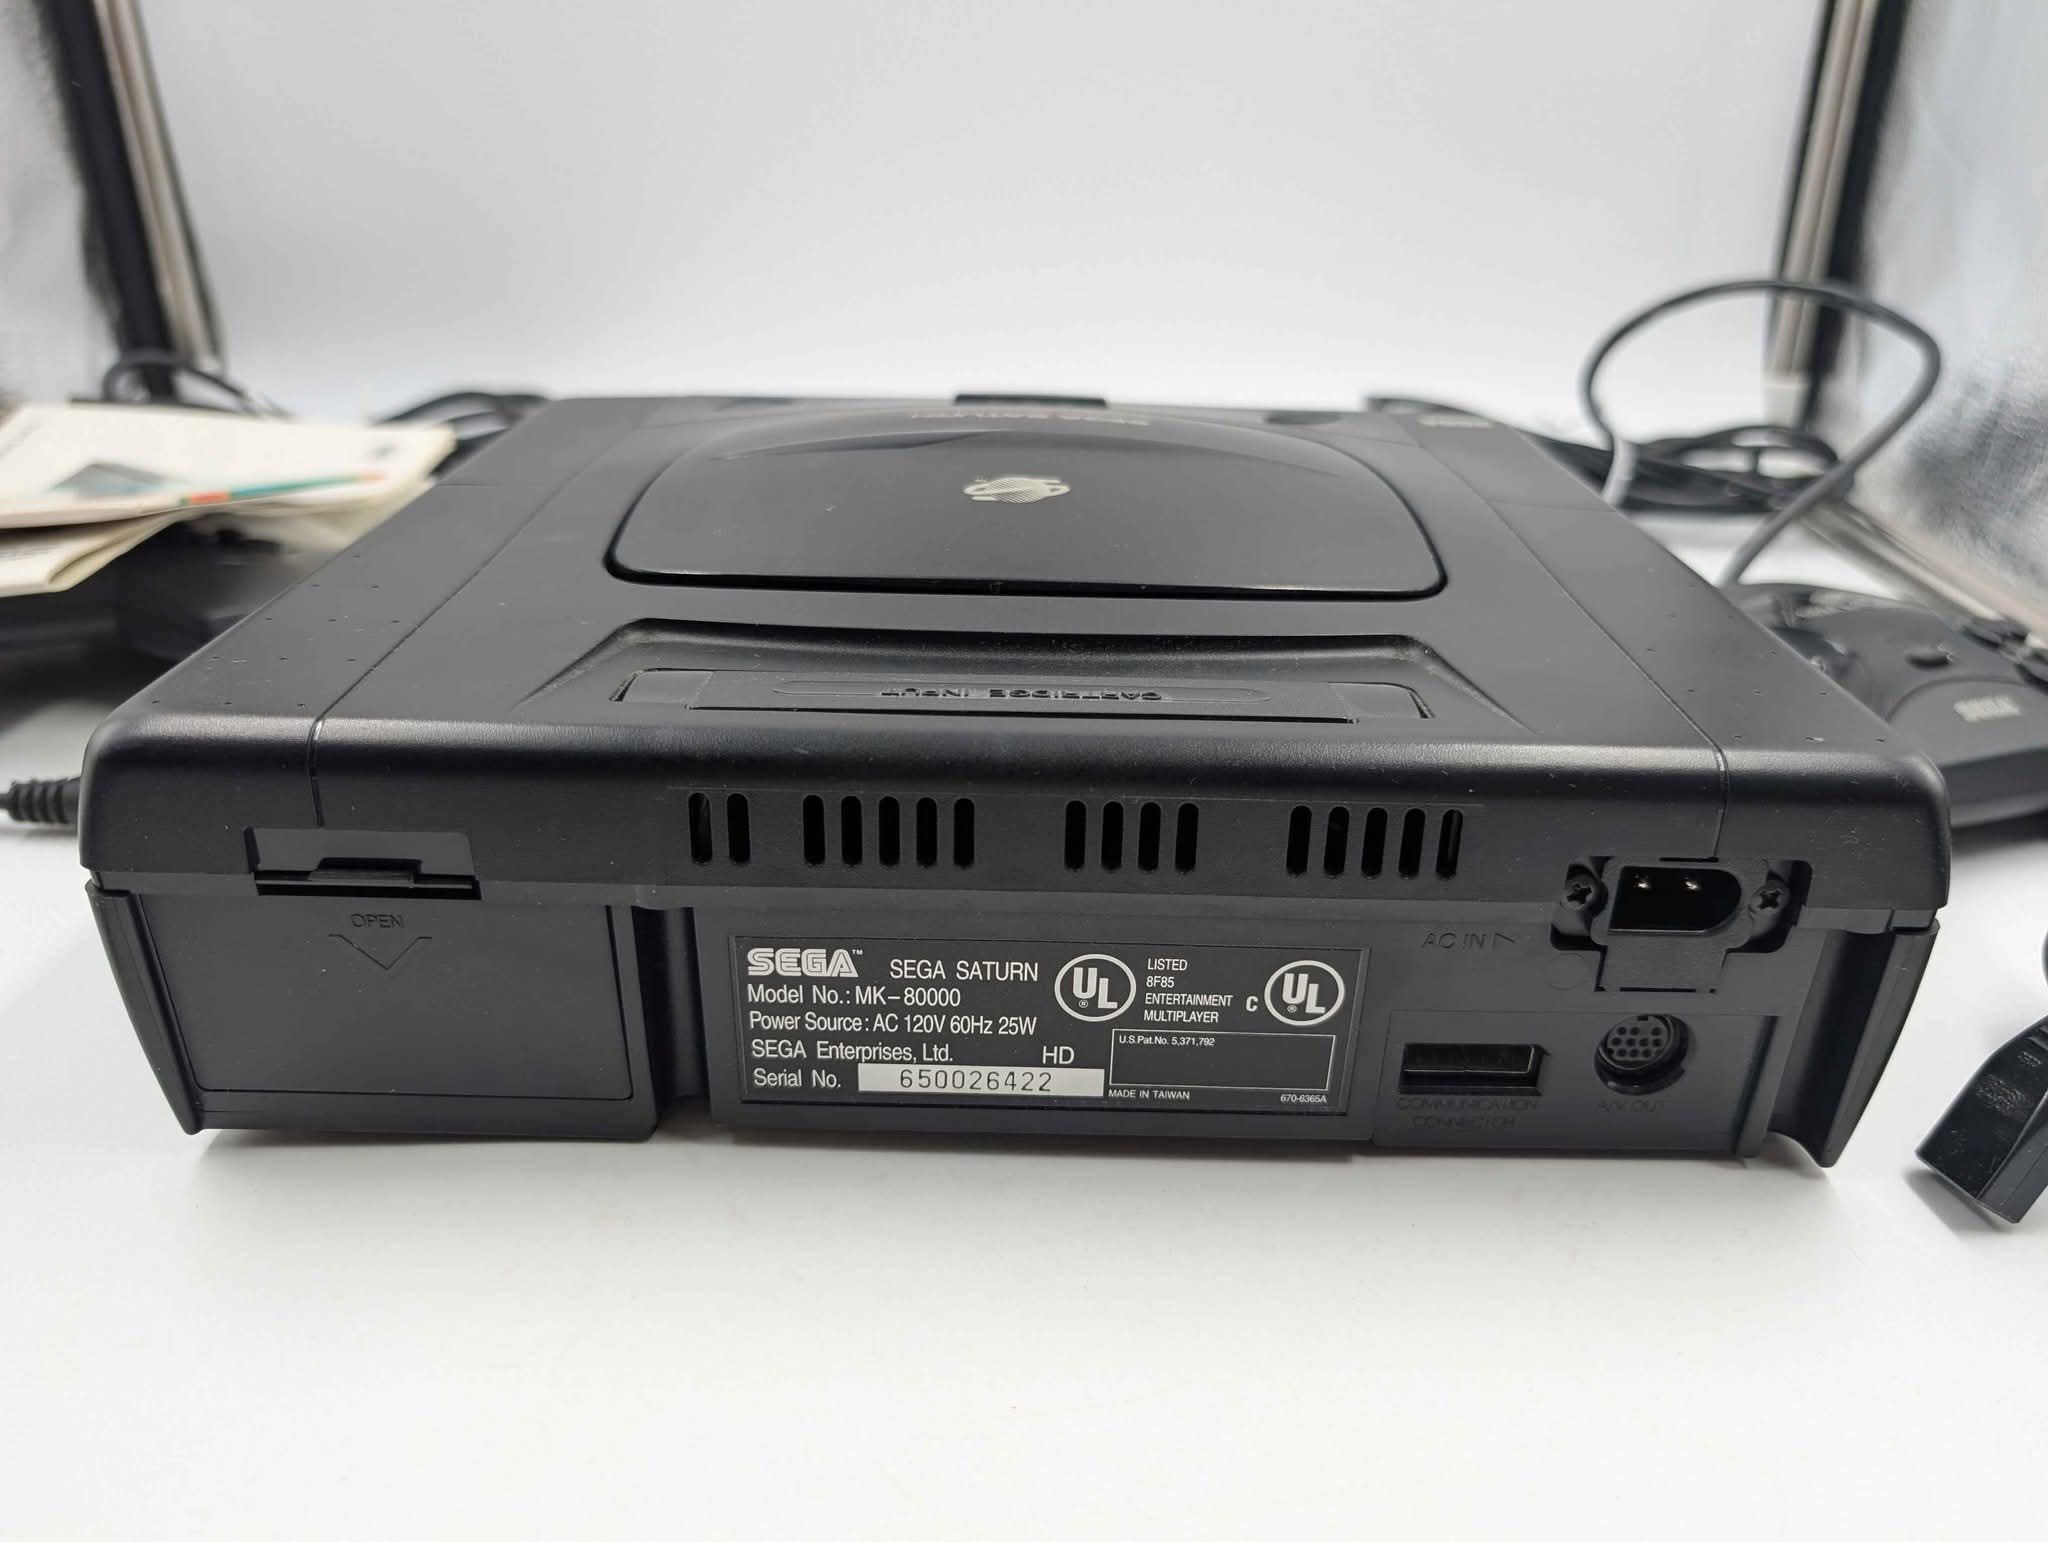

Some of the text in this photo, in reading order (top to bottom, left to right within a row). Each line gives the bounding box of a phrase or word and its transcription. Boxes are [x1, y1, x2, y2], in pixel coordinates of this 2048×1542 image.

[881, 686, 1163, 702] CARTRIDGE INPUT
[350, 913, 404, 928] OPEN
[1421, 932, 1488, 949] AC IN
[747, 948, 859, 978] SEGA
[889, 958, 1039, 982] SEGA SATURN
[1147, 958, 1188, 972] LISTED
[1072, 966, 1118, 1010] UL
[1145, 975, 1175, 989] 8F85
[747, 983, 804, 1004] Model
[855, 985, 961, 1007] MK-80000
[1144, 992, 1233, 1008] ENTERTAINMENT
[1282, 972, 1326, 1014] UL
[749, 1010, 1037, 1036] Power Source: AC 120V 60Hz 25W
[1143, 1009, 1219, 1024] MULTIPLAYER
[1171, 1036, 1216, 1047] 5,371,792
[751, 1039, 954, 1063] SEGA Enterprises, Ltd.
[1041, 1046, 1075, 1065] HD
[753, 1068, 1053, 1092] Serial No. 650026422
[1108, 1089, 1190, 1101] MADE IN TAIWAN
[1280, 1093, 1328, 1104] 670-6365A
